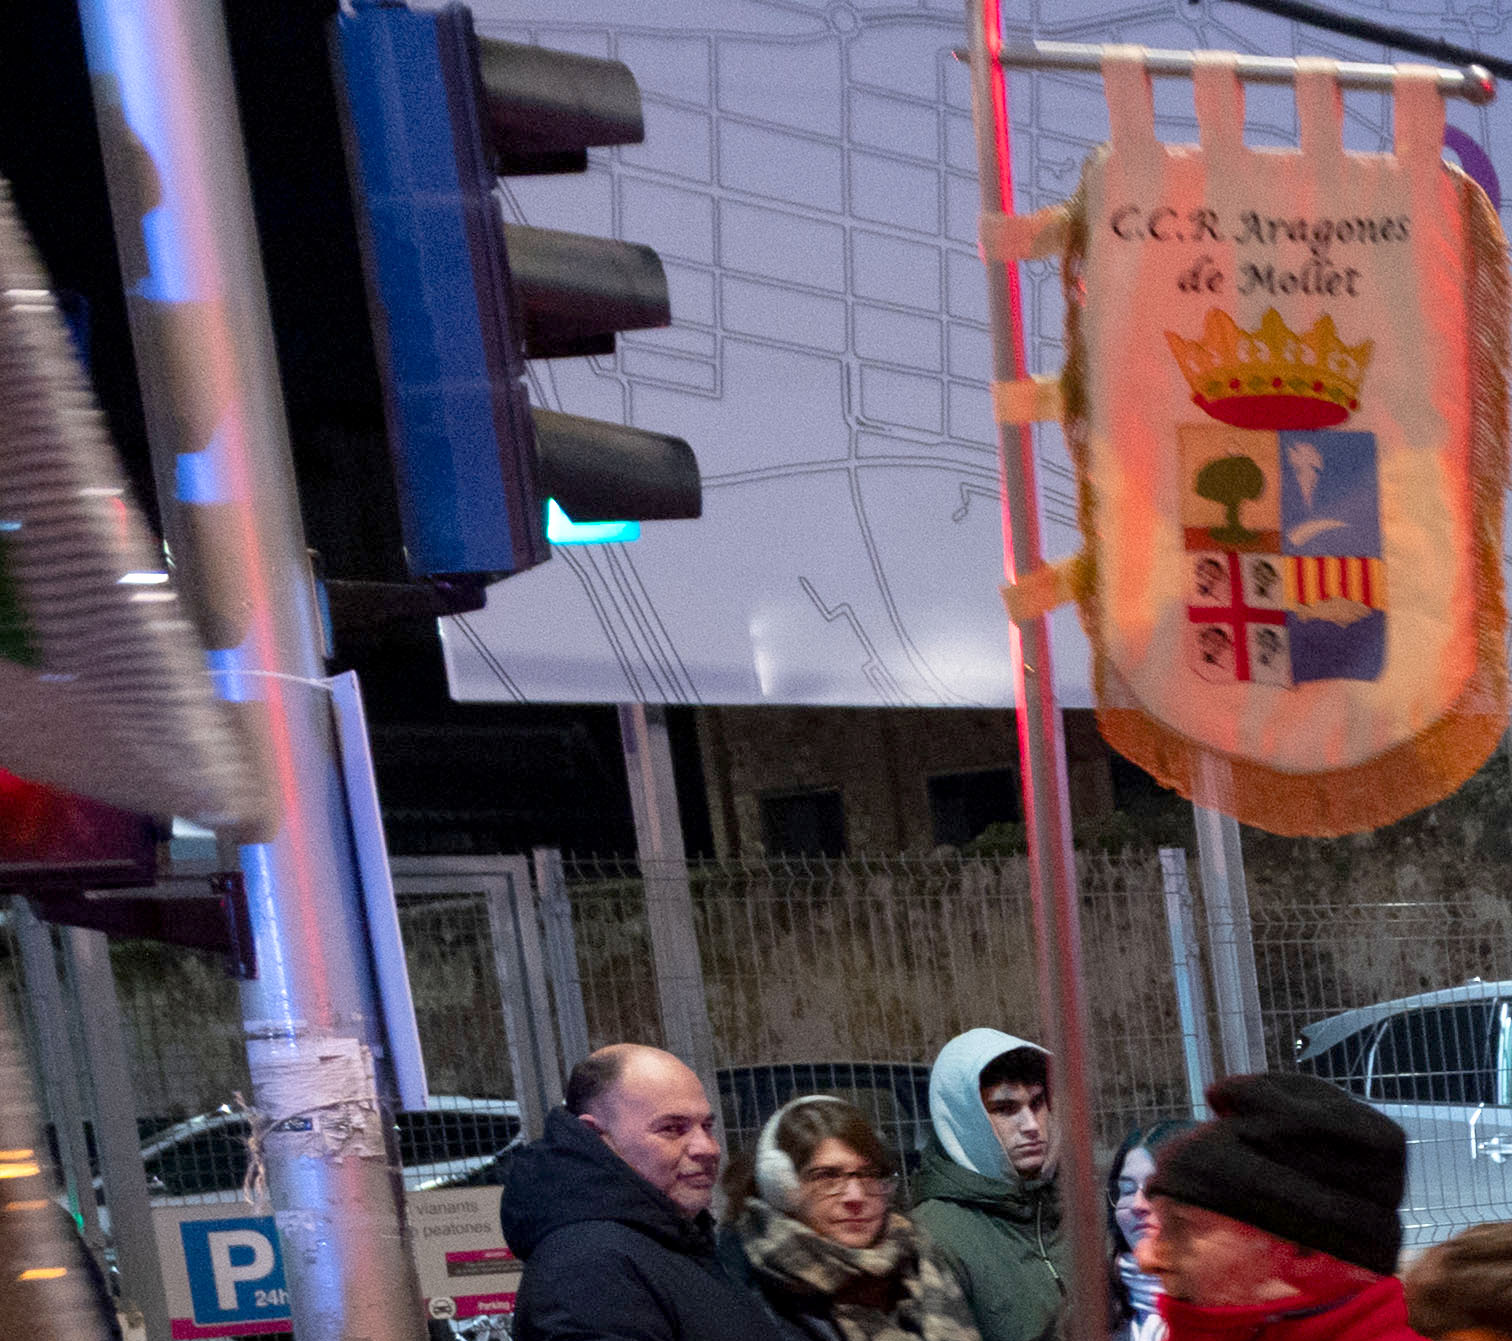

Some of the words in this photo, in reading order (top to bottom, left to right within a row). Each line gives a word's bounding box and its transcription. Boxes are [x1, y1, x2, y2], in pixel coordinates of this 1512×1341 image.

[1177, 255, 1224, 294] de
[1237, 257, 1361, 297] Mollet
[416, 1201, 479, 1215] vianants
[423, 1221, 492, 1239] peatones
[208, 1229, 275, 1311] P
[254, 1288, 289, 1307] 24h
